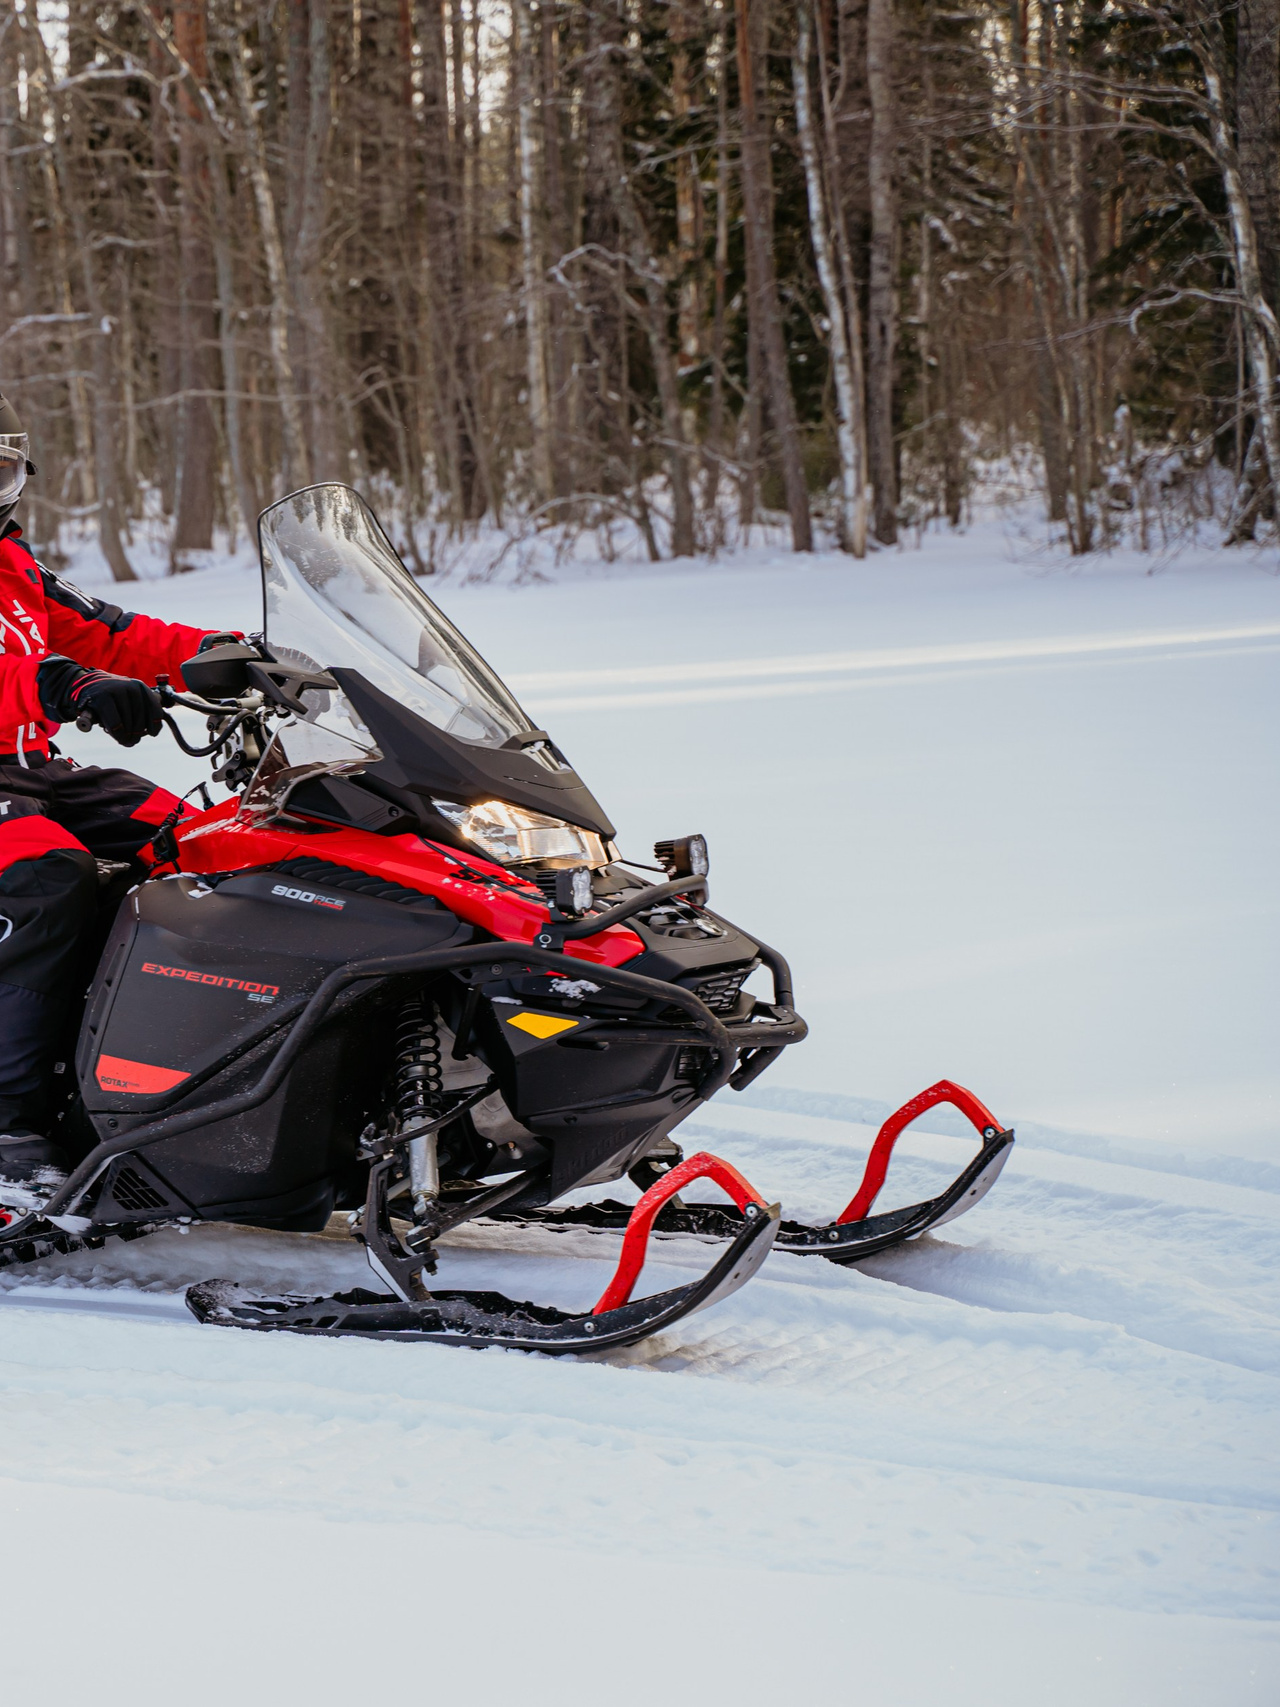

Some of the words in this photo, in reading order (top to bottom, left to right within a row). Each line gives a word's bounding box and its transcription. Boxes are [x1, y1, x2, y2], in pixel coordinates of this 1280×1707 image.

[141, 962, 280, 996] EXPEDITION
[246, 993, 276, 1004] SE
[101, 1075, 128, 1089] ROTAX
